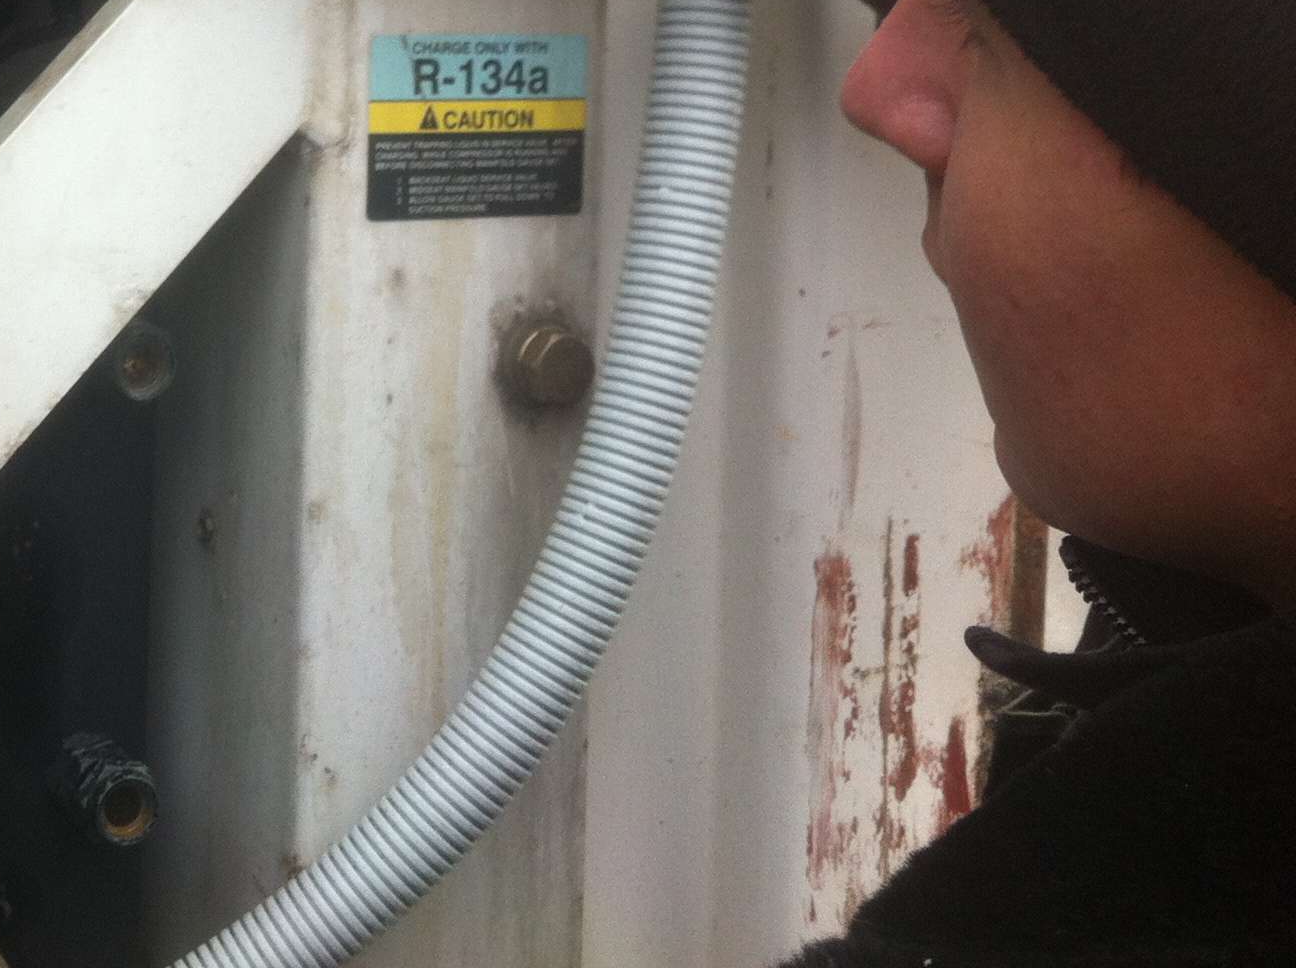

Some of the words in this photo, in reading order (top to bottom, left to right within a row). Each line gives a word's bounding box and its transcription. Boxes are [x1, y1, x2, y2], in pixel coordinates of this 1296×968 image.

[412, 41, 471, 55] CHARGE
[474, 40, 511, 54] ONLY
[514, 40, 549, 54] WITH
[412, 58, 549, 96] R-134a
[442, 109, 535, 130] CAUTION
